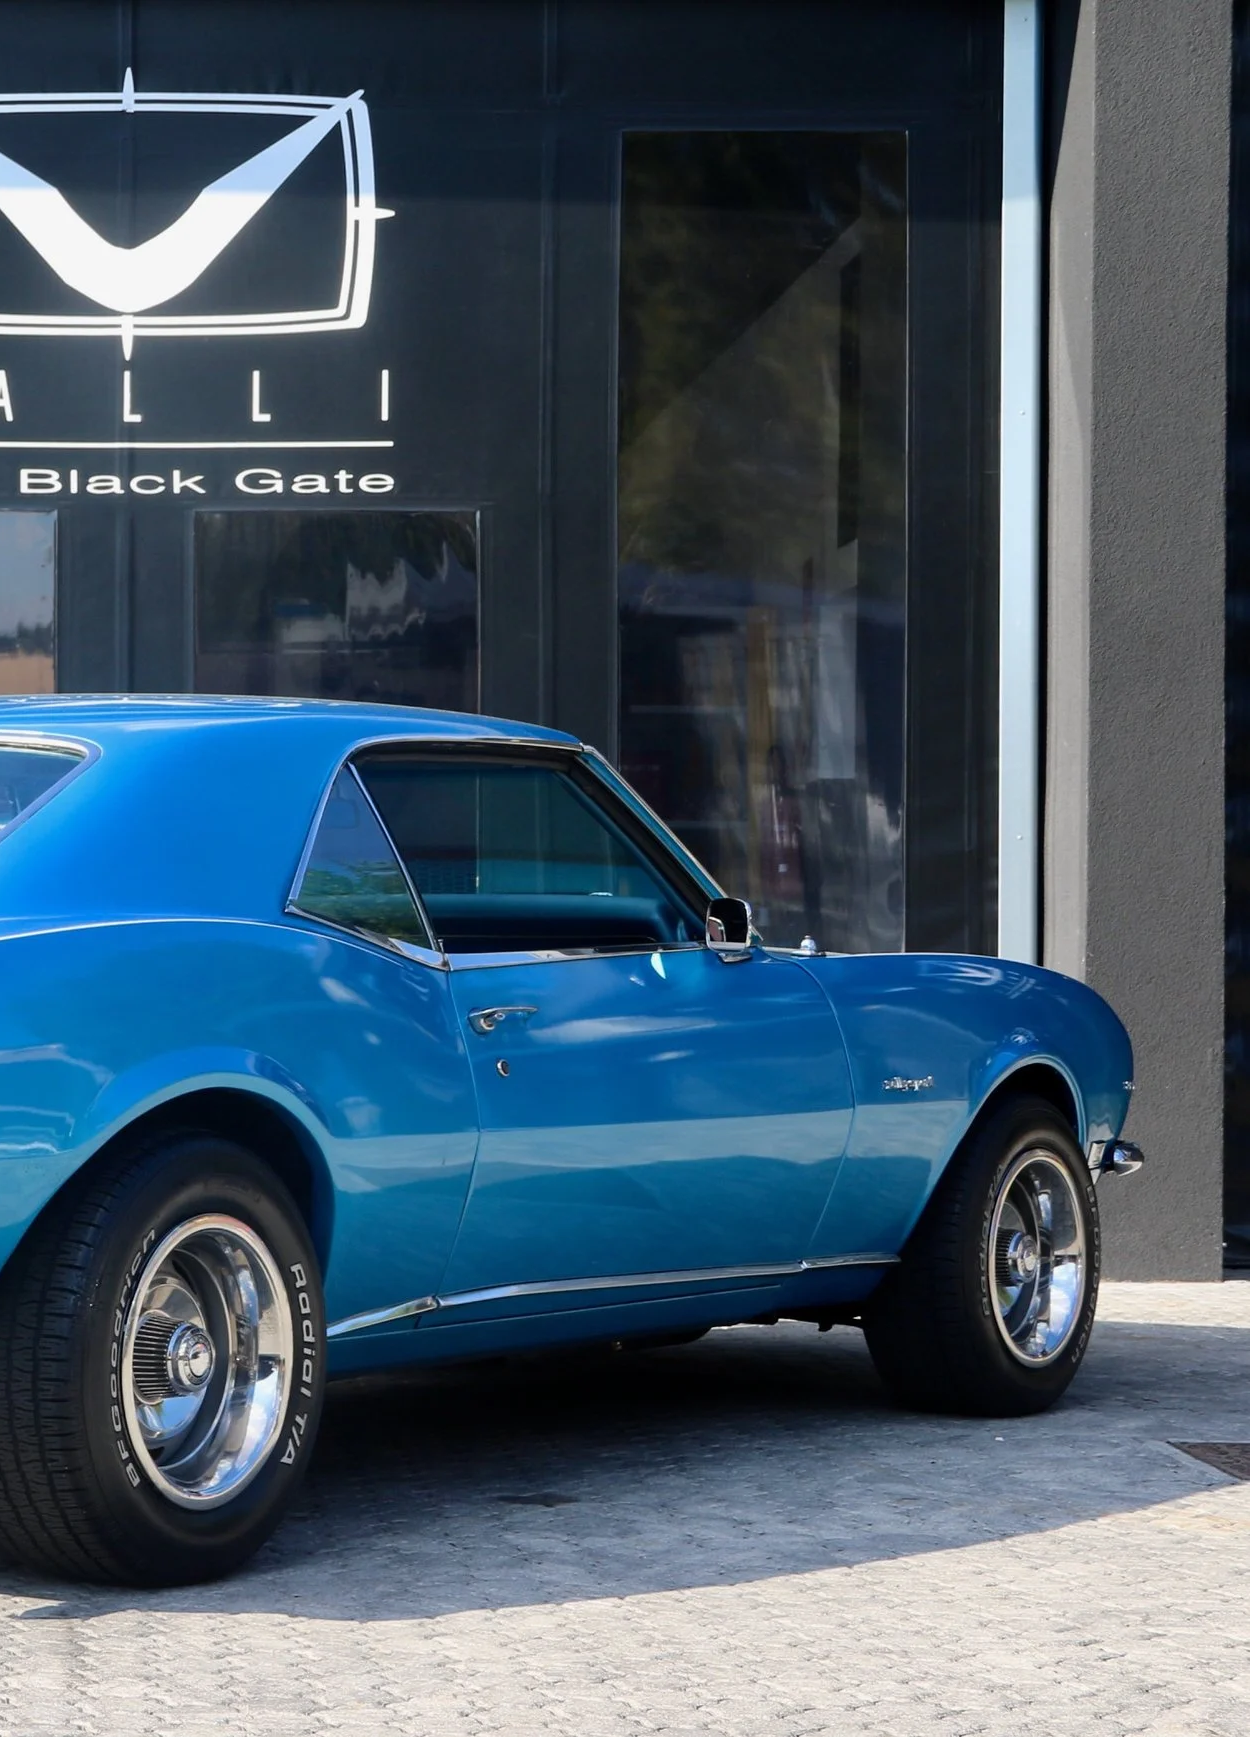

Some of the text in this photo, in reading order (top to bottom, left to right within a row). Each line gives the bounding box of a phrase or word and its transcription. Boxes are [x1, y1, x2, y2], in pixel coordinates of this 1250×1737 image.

[19, 468, 207, 495] Black
[234, 468, 396, 495] Gate
[110, 1227, 156, 1488] BFGoodrich
[280, 1263, 316, 1466] Radial T/A
